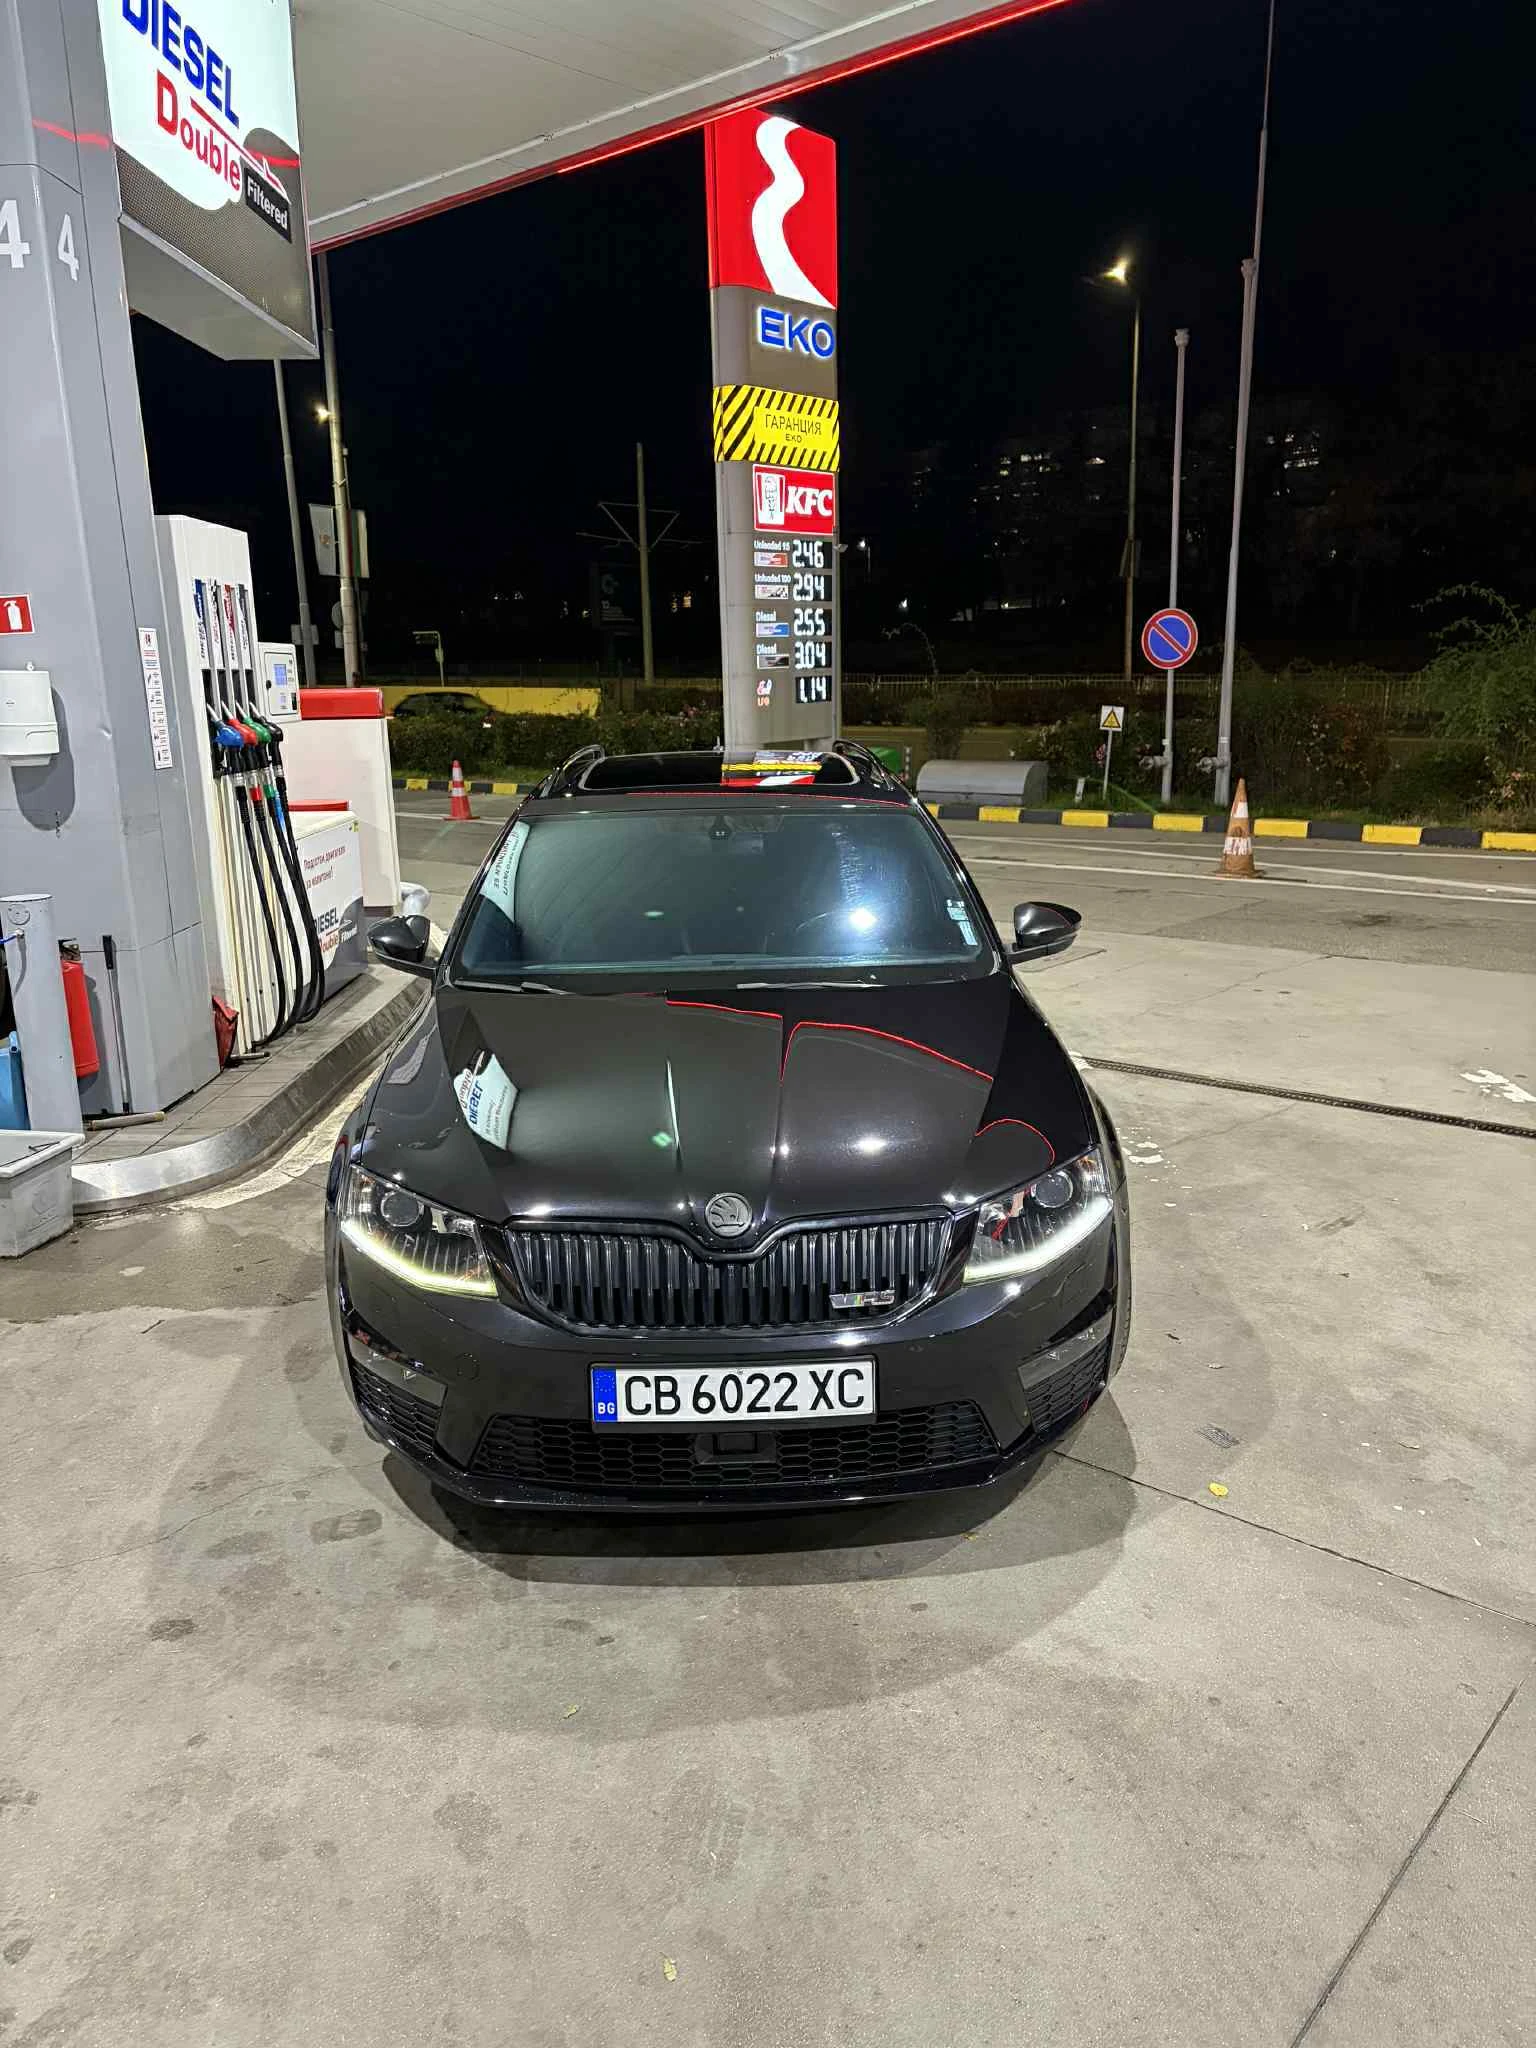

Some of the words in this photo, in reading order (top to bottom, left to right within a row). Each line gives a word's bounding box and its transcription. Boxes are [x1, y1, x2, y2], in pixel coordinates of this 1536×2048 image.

[122, 0, 240, 129] DIESEL
[156, 69, 241, 191] Double
[247, 175, 288, 231] Filtered
[57, 213, 80, 281] 4
[757, 306, 837, 359] EKO
[764, 413, 822, 436] ГАРАНЦИЯ
[785, 485, 833, 517] KFC
[792, 539, 824, 568] 2.46
[793, 572, 825, 602] 2.94
[793, 608, 826, 636] 2.55
[597, 1401, 615, 1414] BG
[624, 1375, 681, 1415] CB
[692, 1371, 798, 1414] 6022
[809, 1368, 865, 1411] XC
